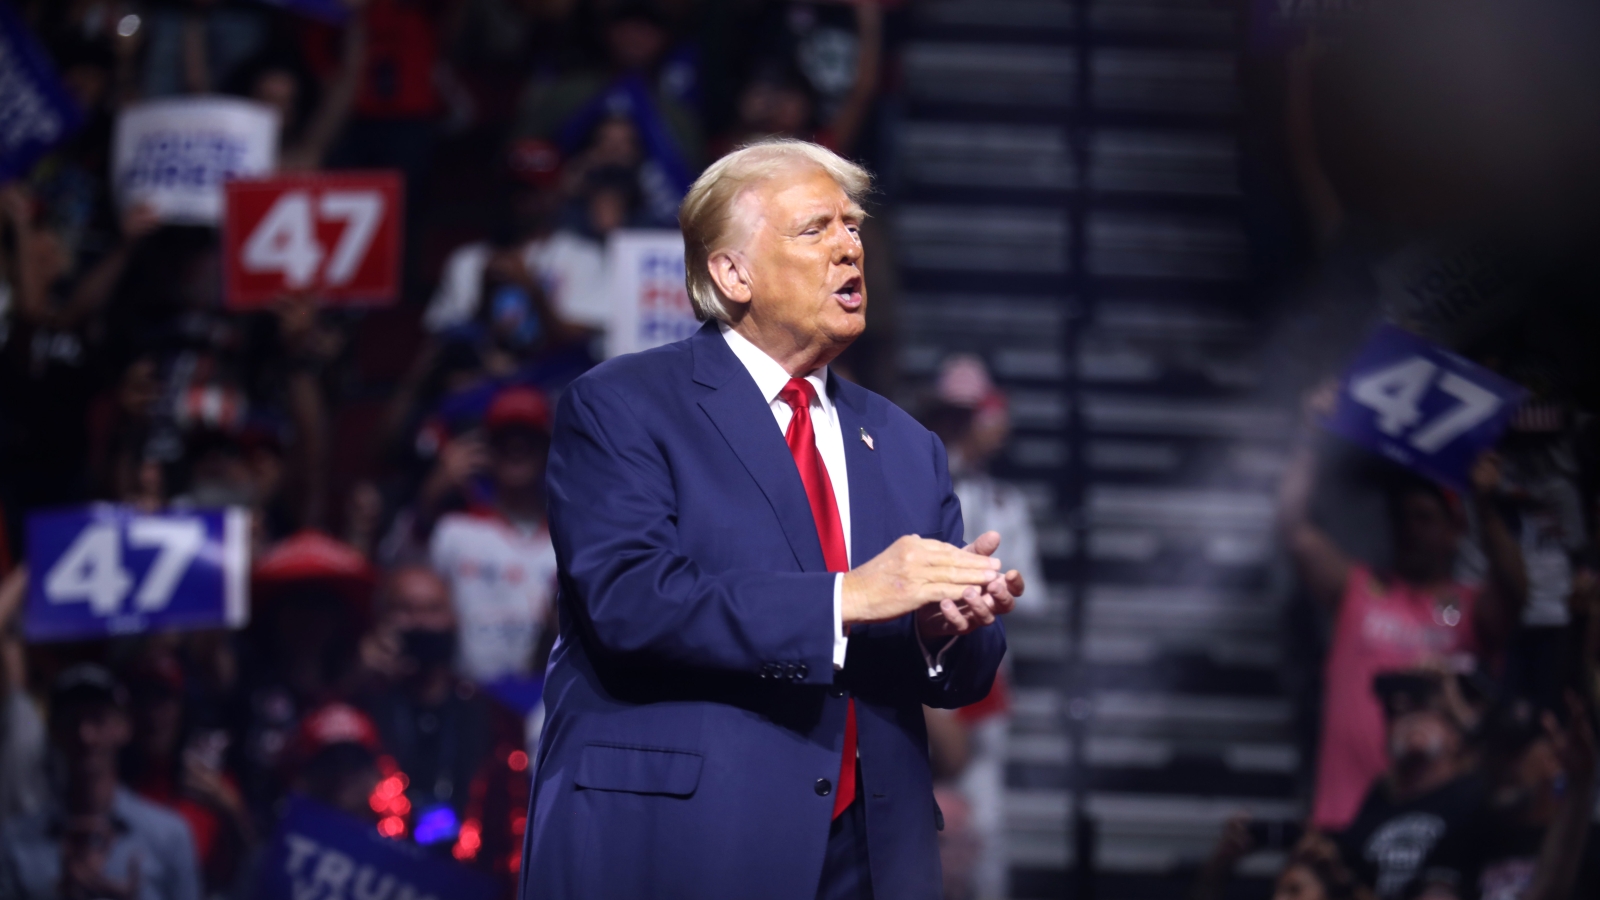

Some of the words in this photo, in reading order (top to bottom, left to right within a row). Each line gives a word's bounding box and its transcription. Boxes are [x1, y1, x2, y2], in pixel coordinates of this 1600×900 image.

[240, 188, 387, 291] 47
[1352, 355, 1504, 455] 47
[43, 515, 208, 618] 47
